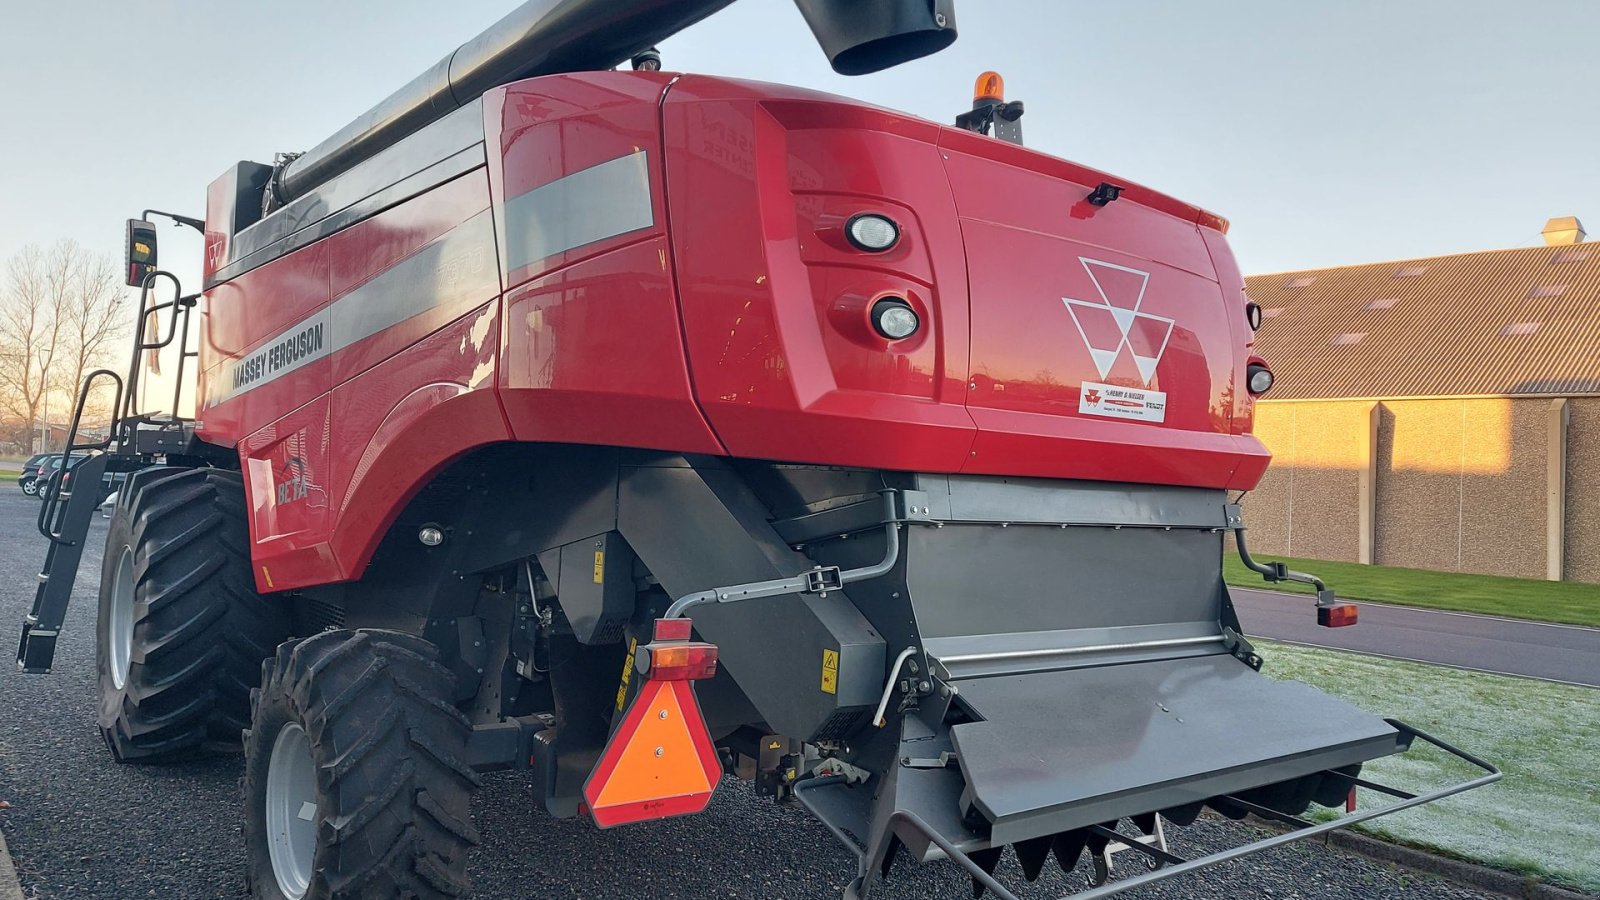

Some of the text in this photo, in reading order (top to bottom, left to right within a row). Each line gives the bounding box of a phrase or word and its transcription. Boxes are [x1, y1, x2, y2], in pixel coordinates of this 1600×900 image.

[233, 322, 323, 390] MASSEY FERGUSON
[278, 475, 308, 506] BETA
